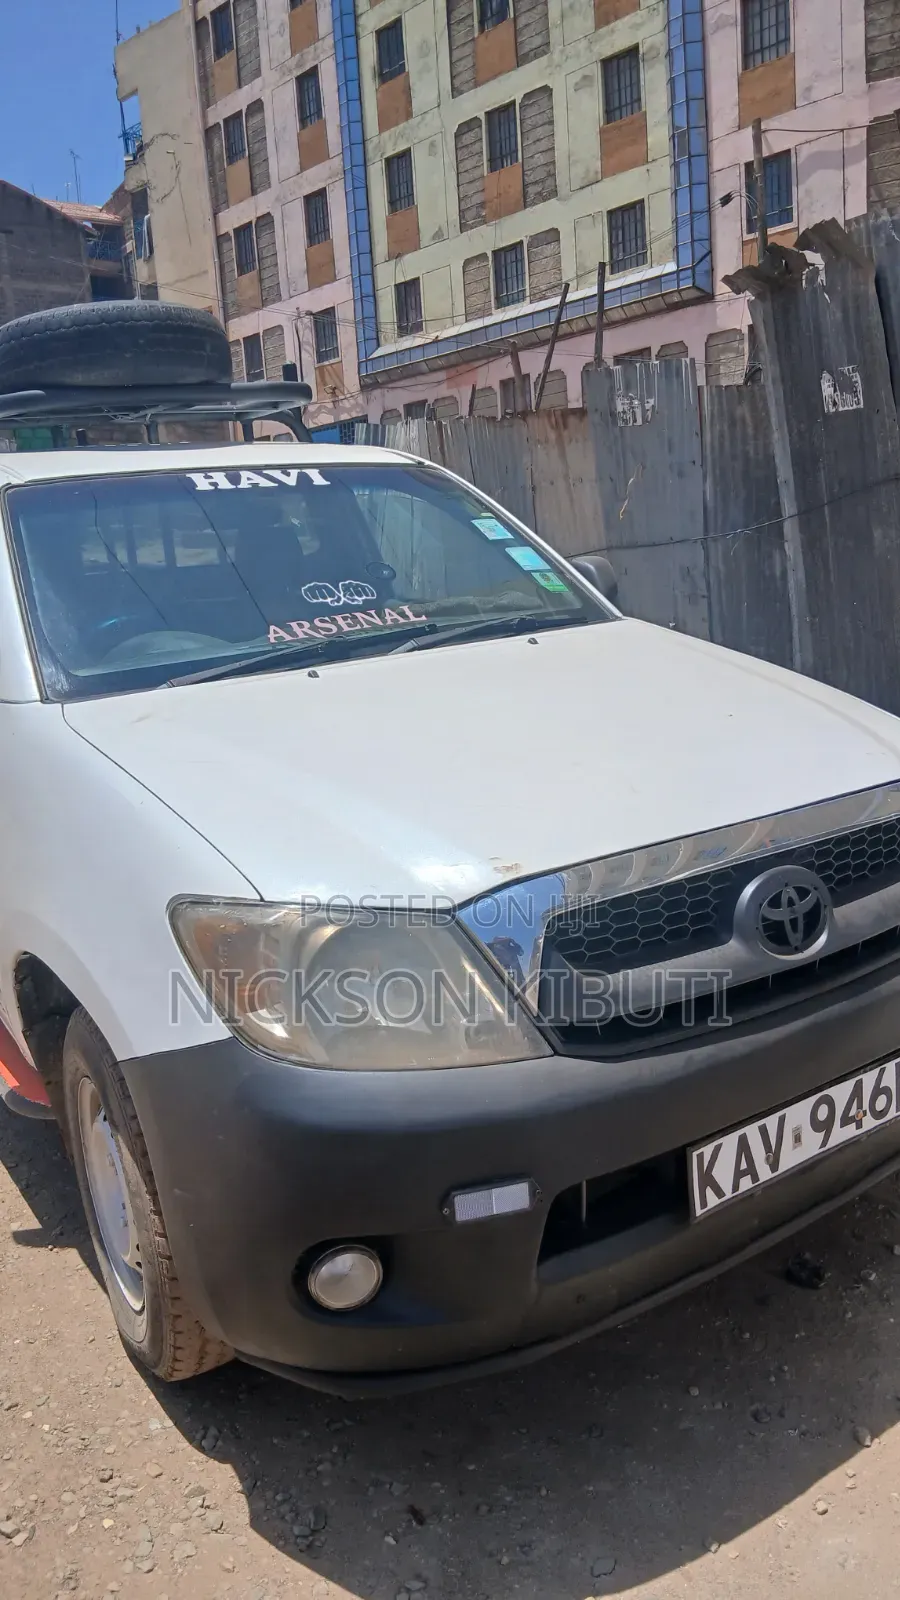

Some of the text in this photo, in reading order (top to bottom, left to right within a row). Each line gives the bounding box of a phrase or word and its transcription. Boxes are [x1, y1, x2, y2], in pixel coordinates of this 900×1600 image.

[185, 468, 331, 491] HAVI
[267, 604, 428, 644] ARSENAL
[695, 1112, 787, 1211] KAV
